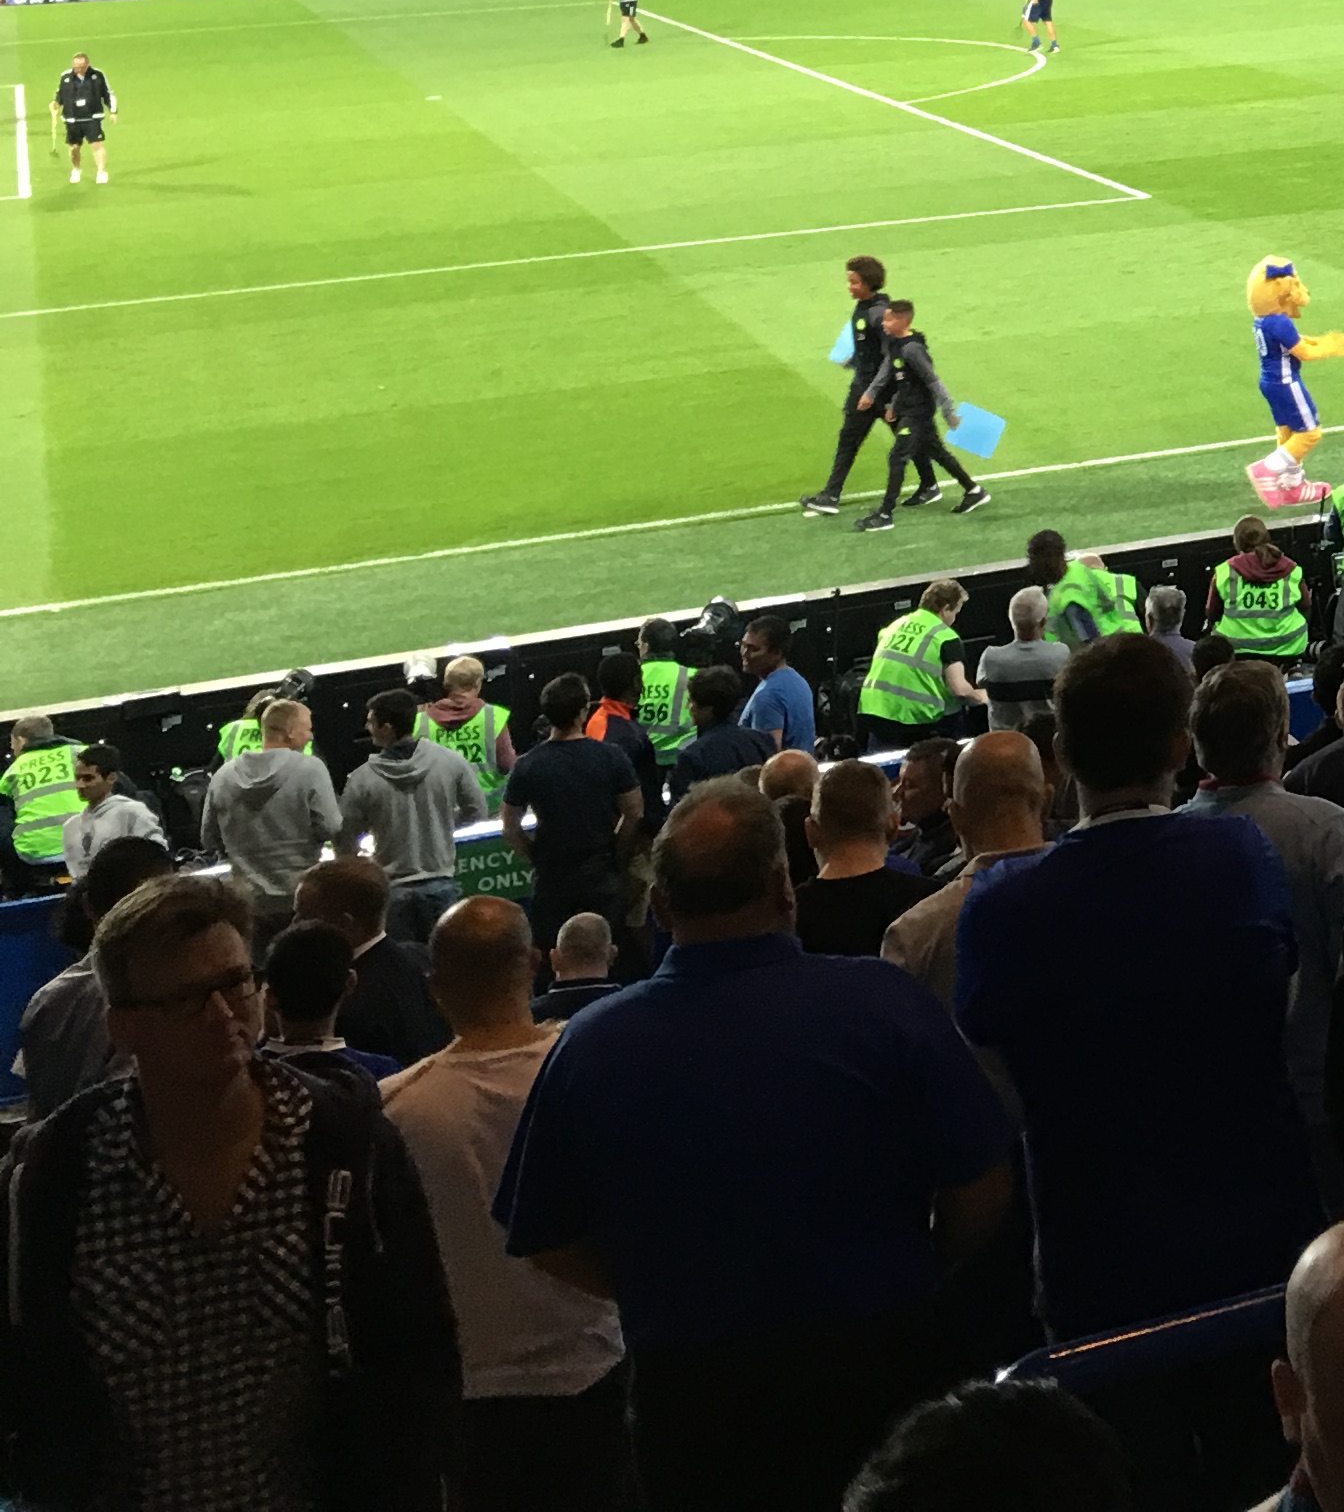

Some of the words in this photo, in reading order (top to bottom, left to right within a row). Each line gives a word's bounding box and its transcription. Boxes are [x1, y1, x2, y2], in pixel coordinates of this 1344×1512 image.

[1243, 591, 1279, 609] 043
[641, 702, 669, 723] 56
[436, 724, 480, 743] PRESS
[19, 750, 65, 773] PRESS
[20, 763, 70, 790] 023
[478, 868, 536, 892] ONLY
